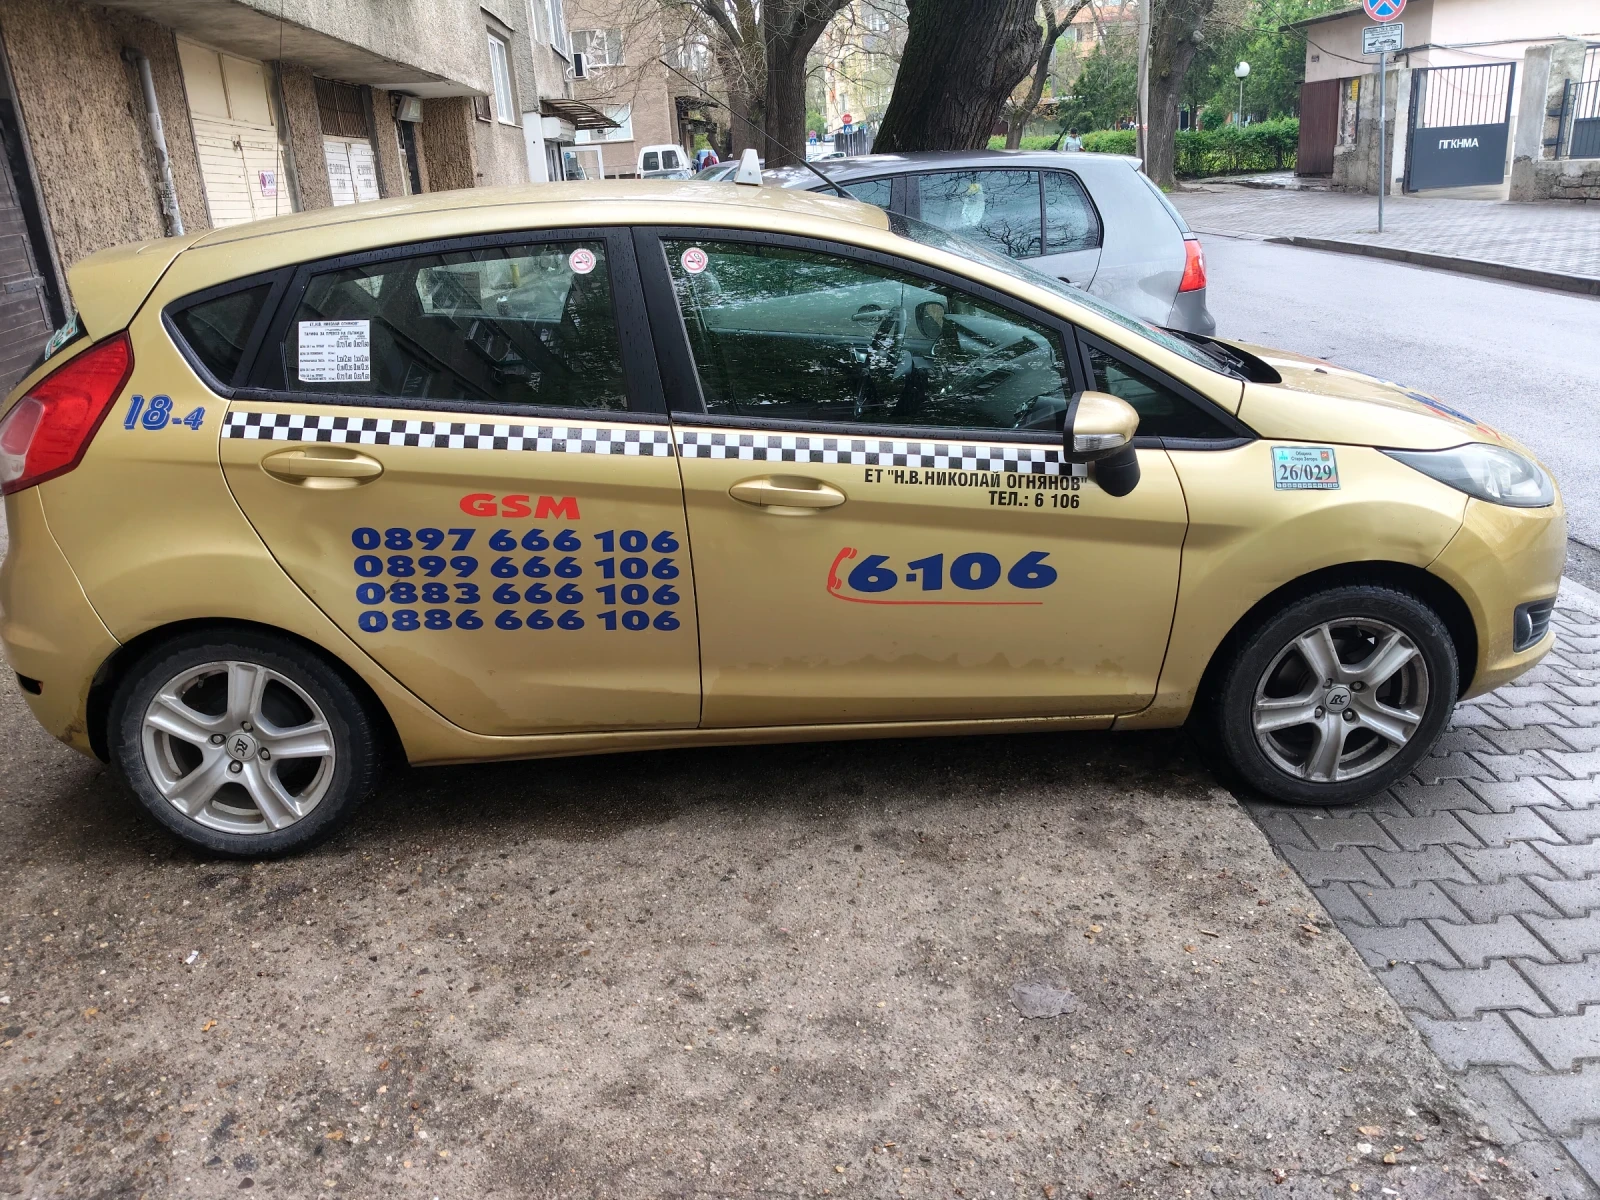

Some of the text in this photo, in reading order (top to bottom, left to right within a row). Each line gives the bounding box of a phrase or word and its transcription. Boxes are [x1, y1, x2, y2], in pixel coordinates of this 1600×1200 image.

[1438, 138, 1479, 150] ПГКНМА
[124, 395, 206, 430] 18-4
[864, 469, 883, 482] ЕТ
[1007, 474, 1088, 491] ОГНЯНОВ"
[1280, 464, 1332, 480] 26/029
[460, 493, 581, 520] GSM
[989, 491, 1080, 508] ТЕЛ.: 6 106
[352, 527, 679, 553] 0897 666 106
[354, 555, 679, 579] 0899 666 106
[356, 582, 680, 605] 0883 666 106
[358, 609, 680, 632] 0886 666 106
[1330, 694, 1348, 705] RC
